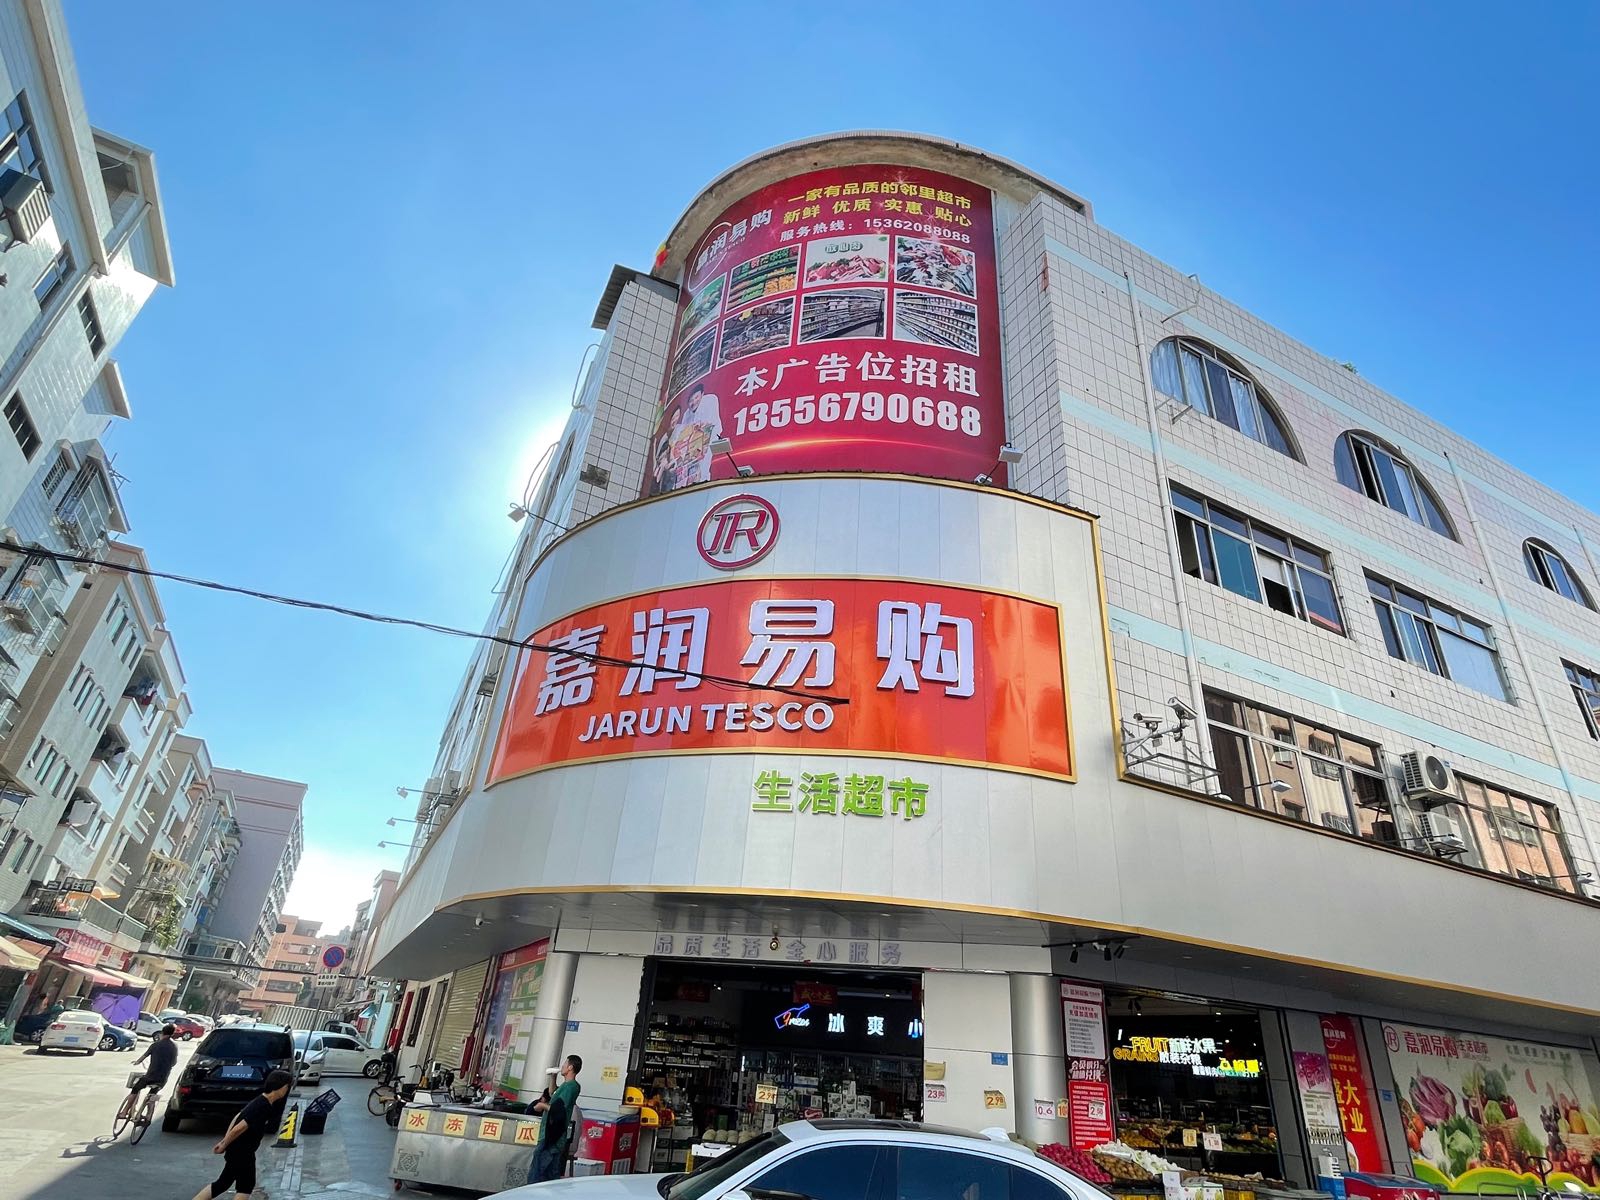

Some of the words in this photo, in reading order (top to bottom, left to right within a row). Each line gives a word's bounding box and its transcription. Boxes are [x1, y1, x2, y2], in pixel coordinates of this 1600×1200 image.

[783, 205, 820, 225] 新鲜
[832, 198, 871, 214] 优质
[885, 198, 922, 215] 实惠
[935, 205, 972, 228] 贴心
[788, 181, 971, 209] 一家有品质的邻里超市
[864, 218, 970, 244] 15362088088
[734, 351, 980, 397] 本广告位招租
[733, 392, 981, 437] 13556790688
[534, 599, 975, 716] 嘉润易购
[578, 705, 692, 742] JARUN
[701, 702, 835, 732] TESCO
[752, 769, 930, 820] 生活超市
[655, 934, 760, 959] 品质生活
[786, 939, 903, 966] 全心服务
[408, 1113, 535, 1142] 冰冻西瓜
